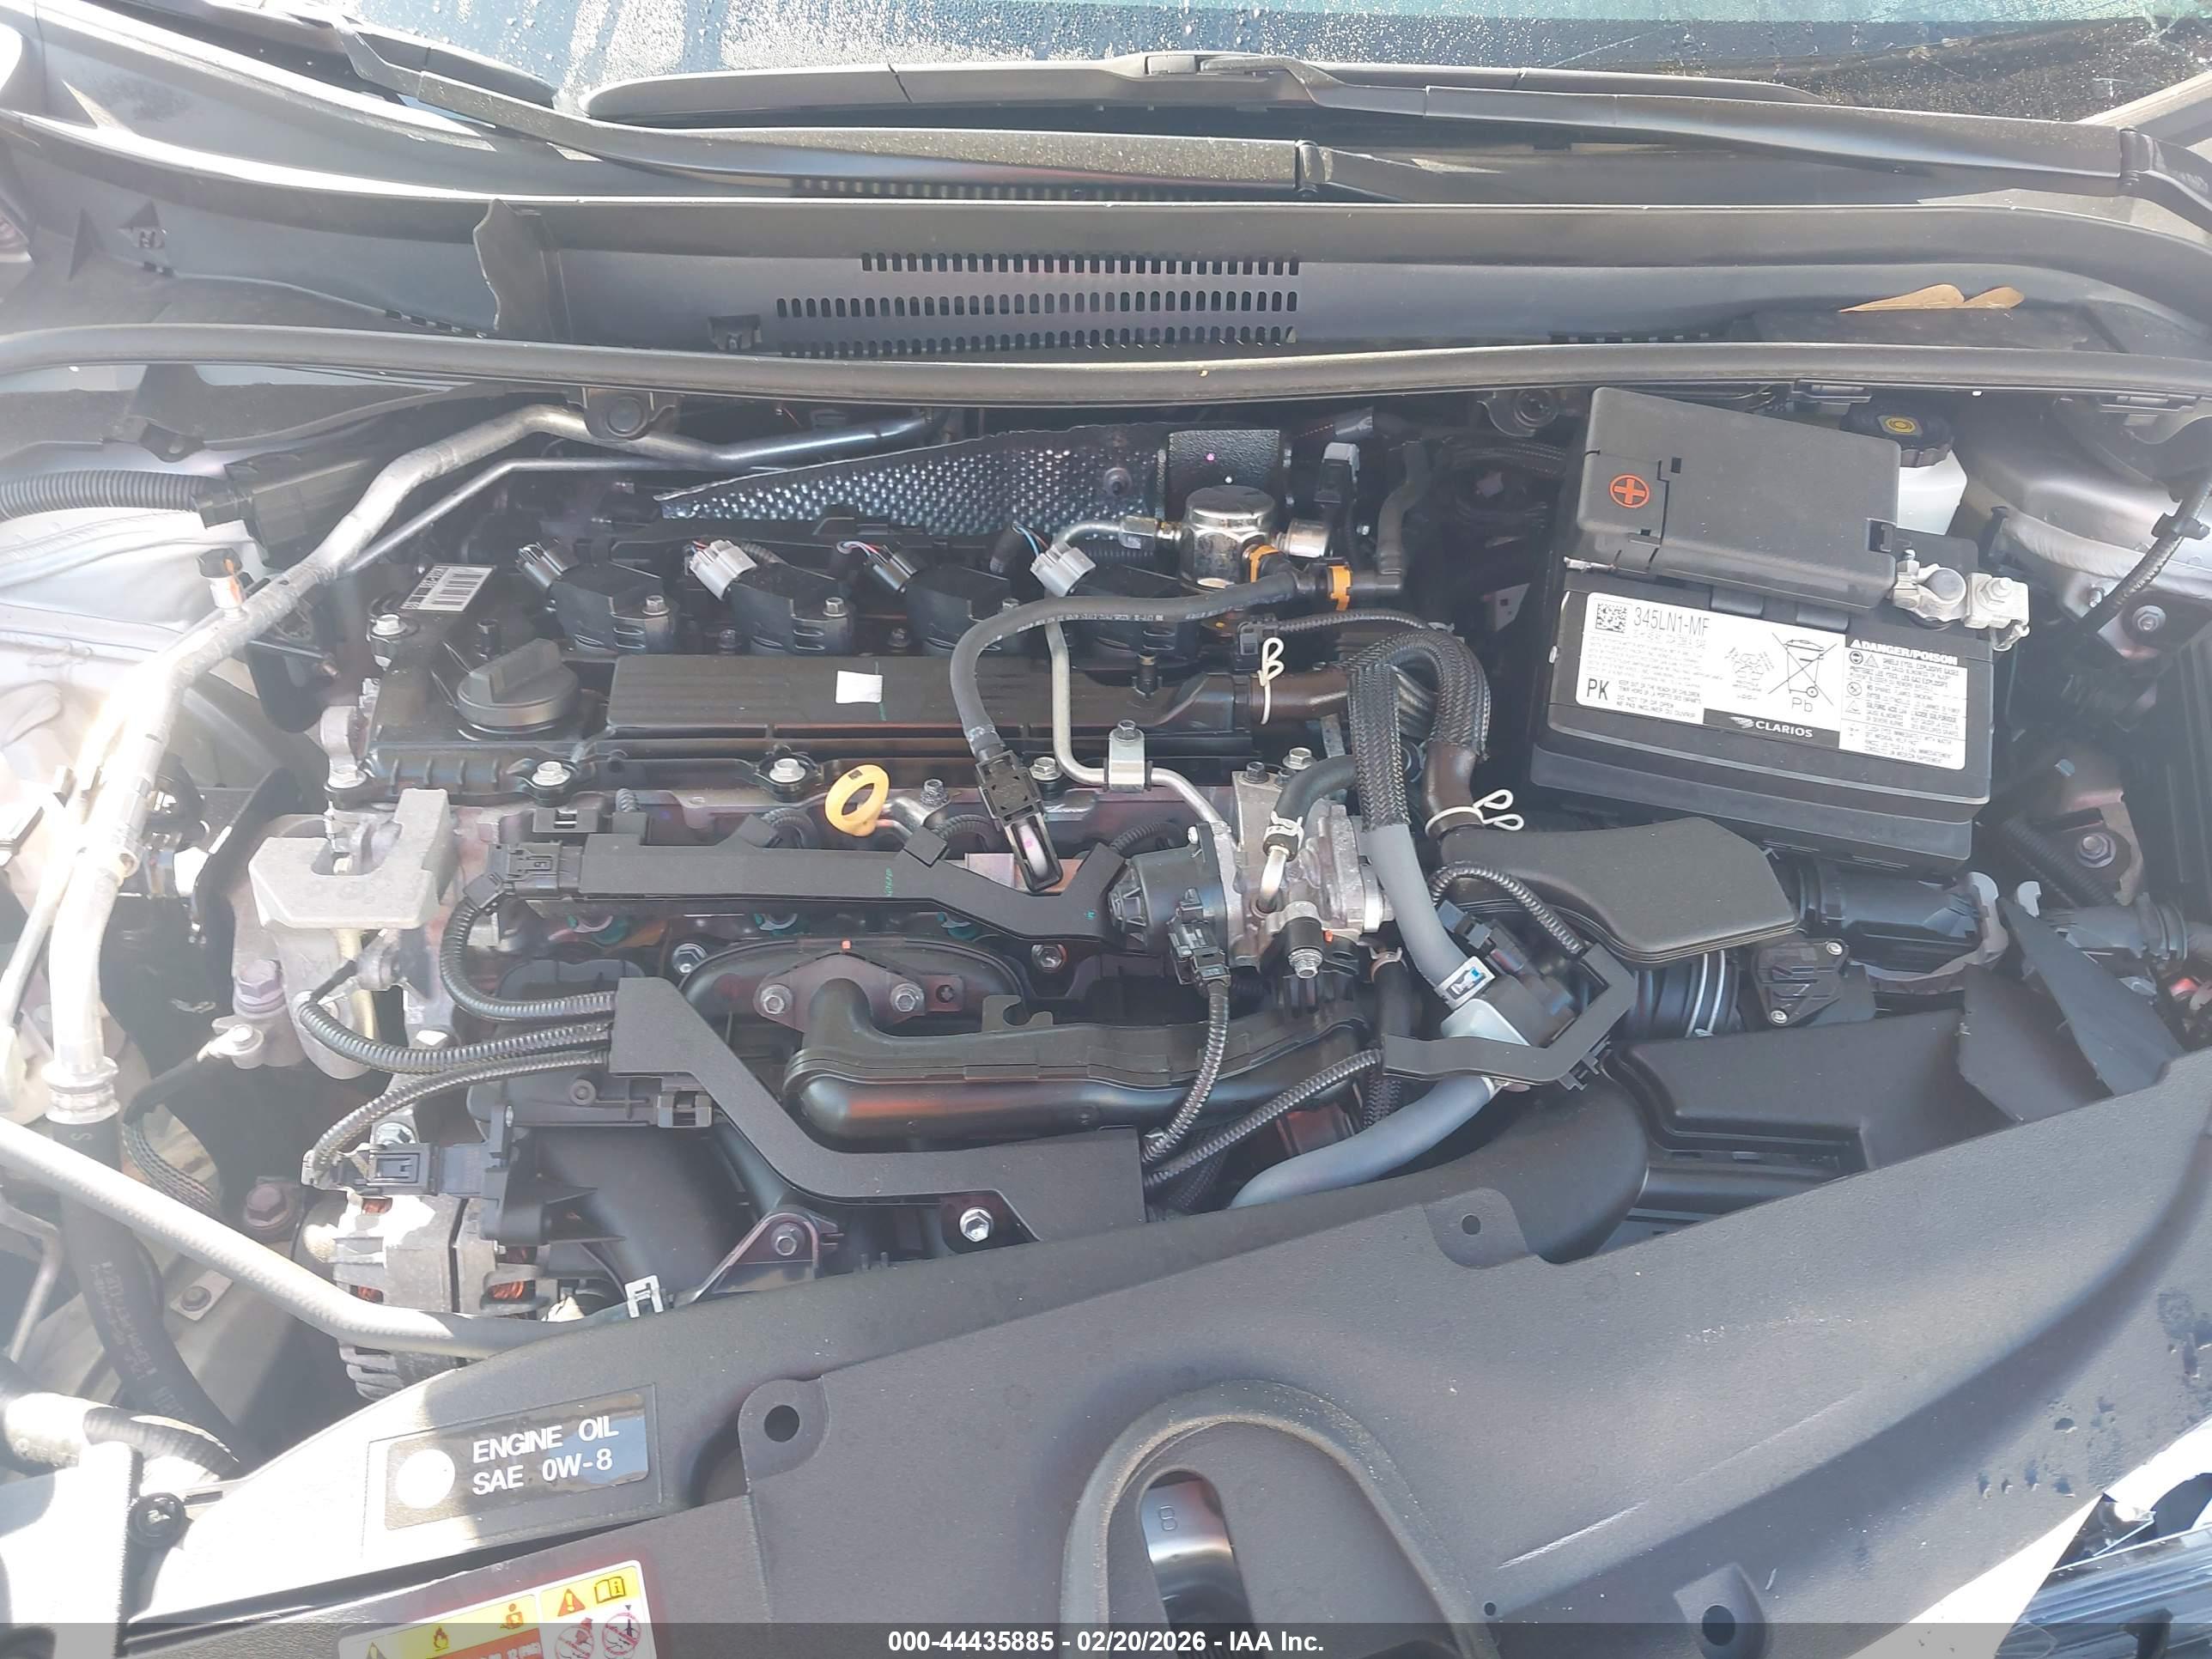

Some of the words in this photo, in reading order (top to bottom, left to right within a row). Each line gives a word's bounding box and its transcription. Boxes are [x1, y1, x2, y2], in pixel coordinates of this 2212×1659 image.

[1633, 606, 1710, 636] 345LN1-MF
[1861, 641, 1959, 666] DANGER/POISON
[1587, 678, 1609, 701] PK
[1791, 696, 1814, 713] Pb
[1755, 720, 1814, 738] CLARIOS
[473, 1425, 563, 1463] ENGINE
[578, 1415, 619, 1442] OIL
[472, 1464, 524, 1495] SAE
[542, 1448, 613, 1482] 0W-8
